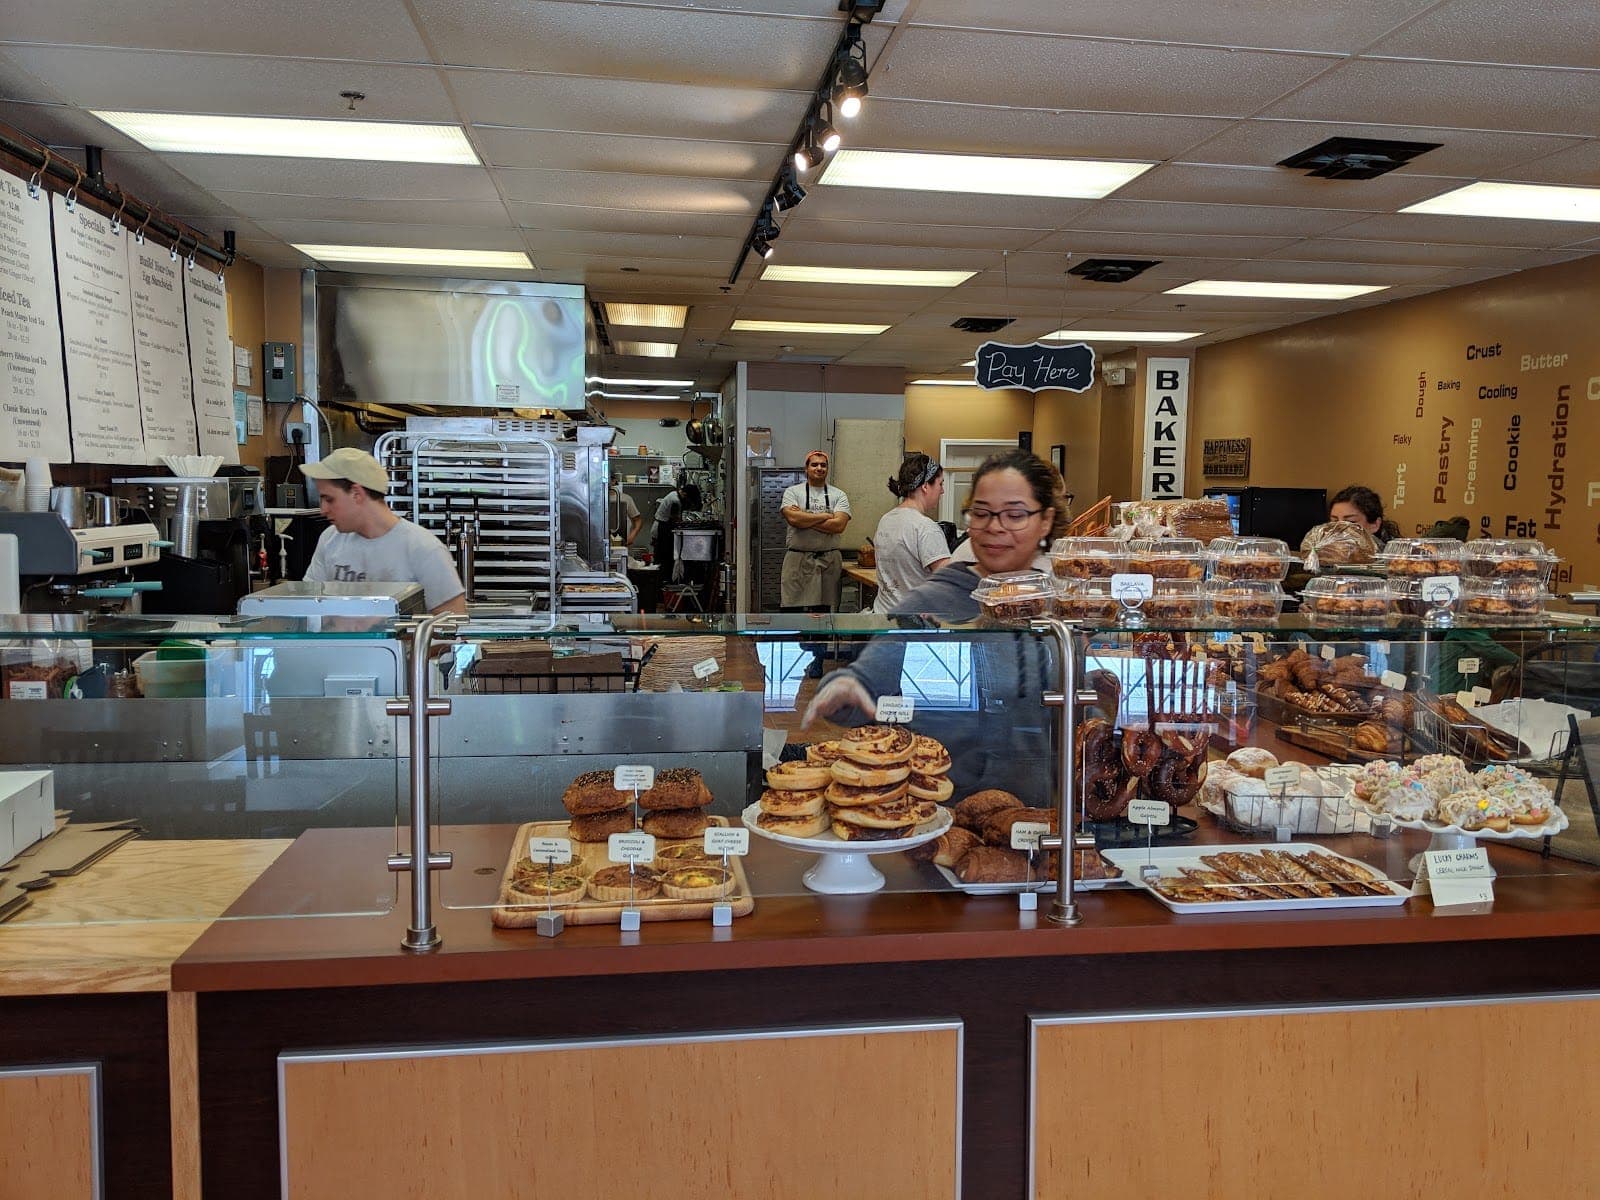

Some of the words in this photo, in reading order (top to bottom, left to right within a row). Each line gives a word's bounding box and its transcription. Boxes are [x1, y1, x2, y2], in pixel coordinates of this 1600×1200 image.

[79, 212, 106, 235] Specials
[1466, 343, 1502, 360] Crust
[1521, 353, 1568, 372] Butter
[985, 351, 1026, 386] Pay
[1032, 355, 1079, 383] Here
[1416, 371, 1427, 418] Dough
[1437, 379, 1461, 391] Baking
[1478, 384, 1518, 400] Cooling
[1152, 370, 1183, 500] BAKER
[1434, 415, 1455, 504] Pastry
[1463, 417, 1483, 505] Creaming
[1503, 414, 1522, 491] Cookie
[1544, 384, 1571, 530] Hydration
[1393, 463, 1408, 509] Tart
[1505, 515, 1537, 538] Fat
[333, 564, 367, 582] The
[1434, 855, 1452, 864] LUCKY
[1455, 852, 1479, 862] CHARMS
